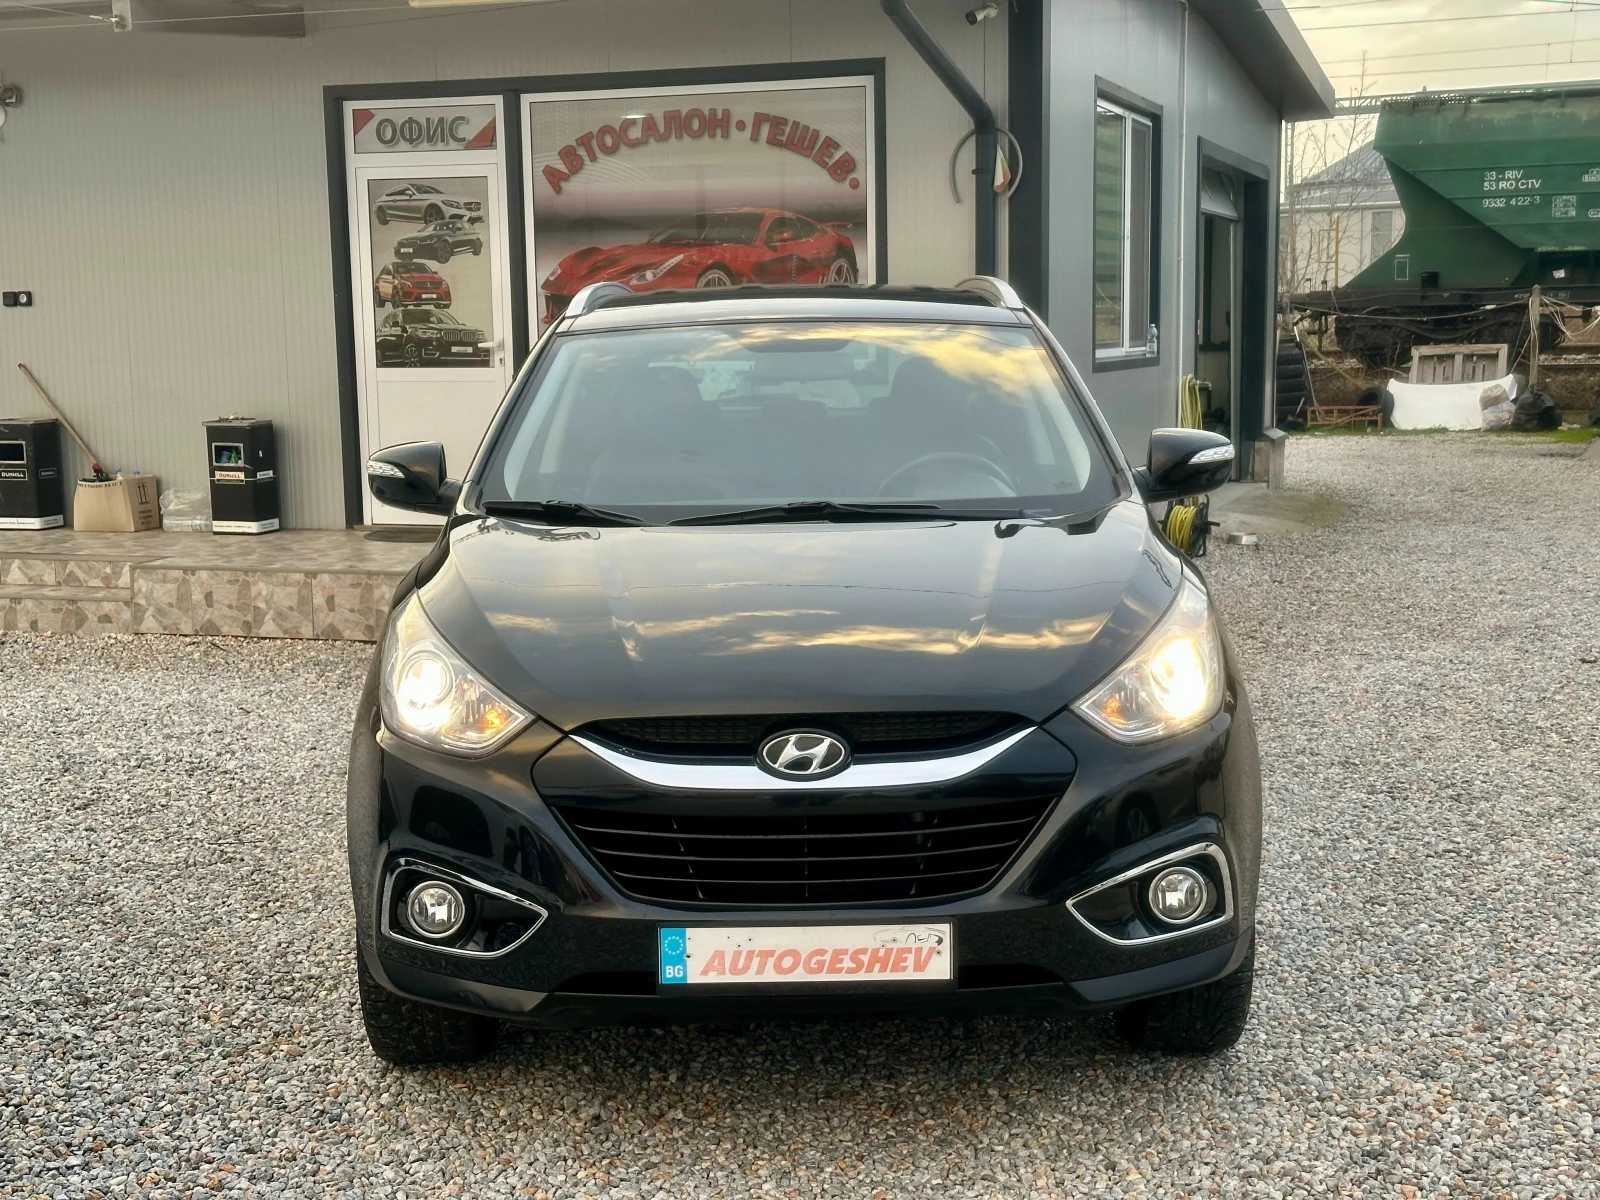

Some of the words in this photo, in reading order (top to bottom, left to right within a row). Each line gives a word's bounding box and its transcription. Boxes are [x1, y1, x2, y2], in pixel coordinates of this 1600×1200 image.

[375, 115, 468, 146] ОФИС
[541, 107, 730, 195] АВТОСАЛОН
[1484, 171, 1496, 181] 33
[1504, 169, 1524, 180] RIV
[1483, 181, 1496, 191] 53
[1498, 180, 1516, 190] RO
[1518, 179, 1542, 189] CTV
[1482, 197, 1506, 208] 9332
[699, 946, 937, 977] AUTOGESHEV
[665, 965, 684, 978] BG
